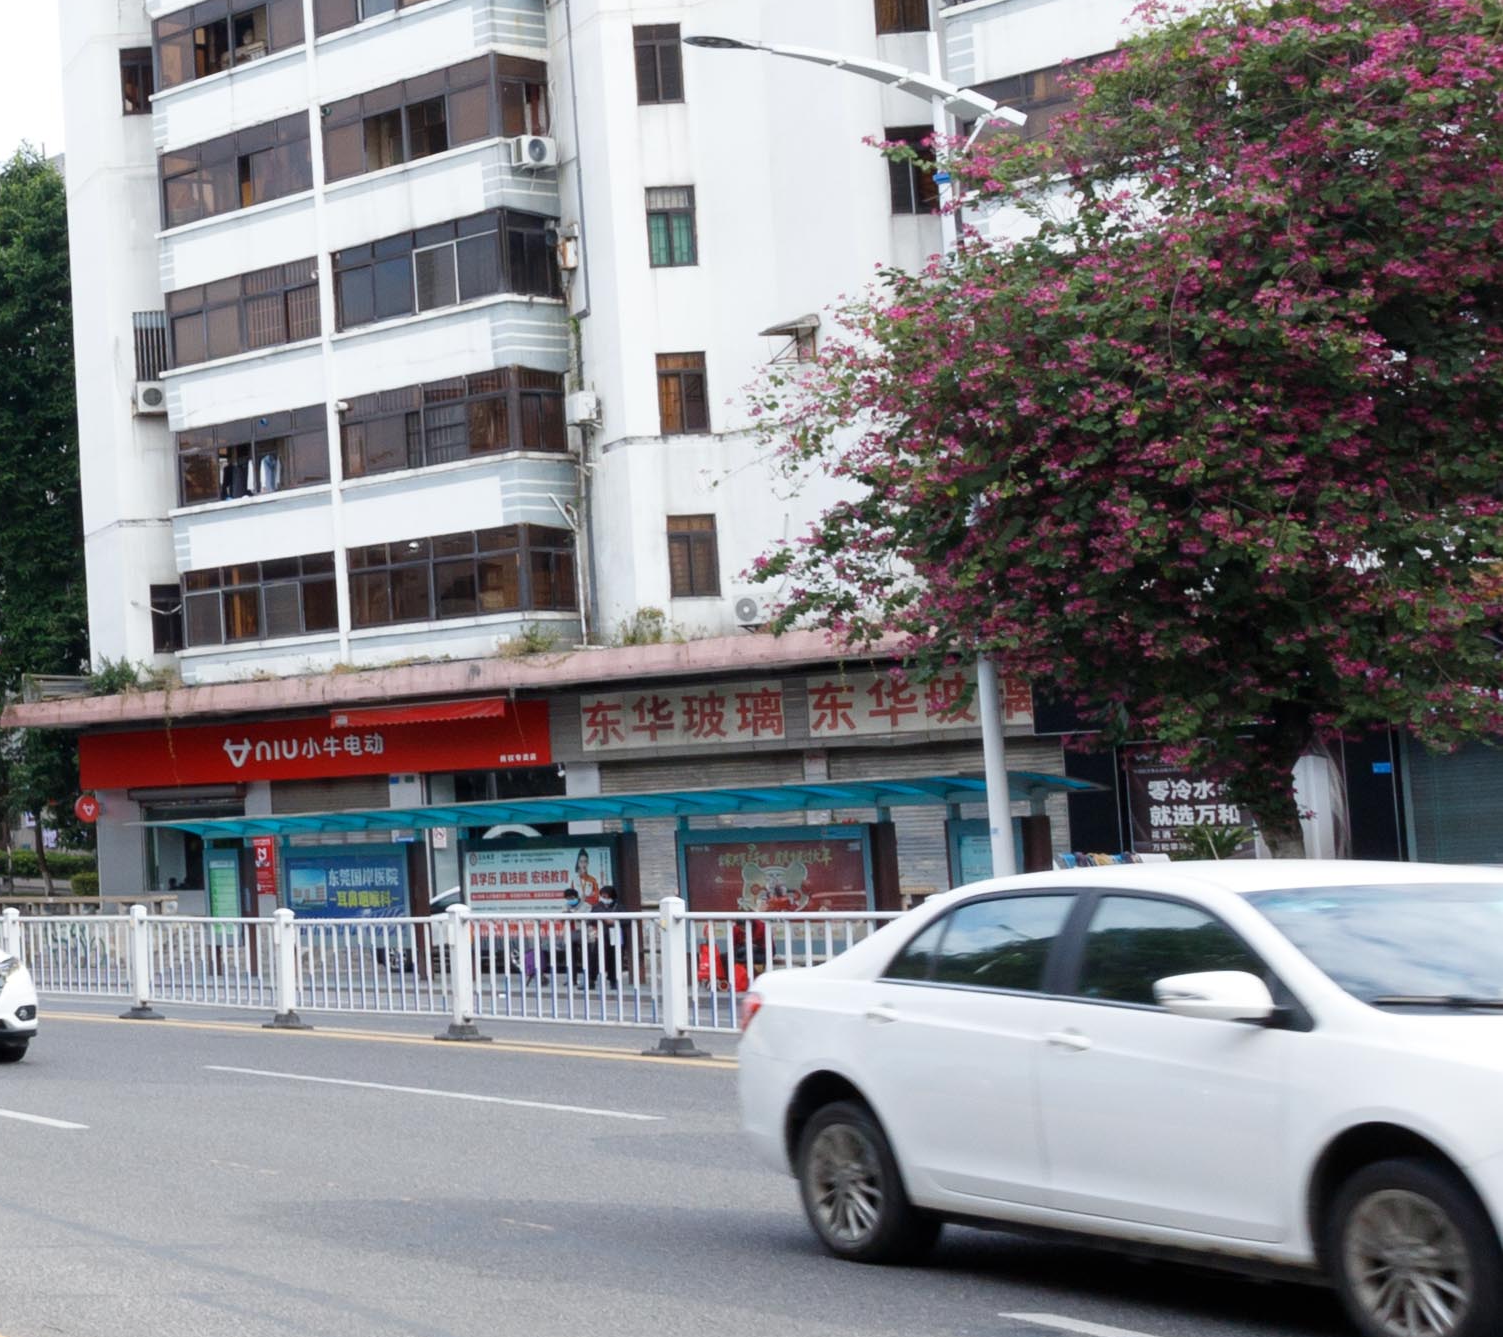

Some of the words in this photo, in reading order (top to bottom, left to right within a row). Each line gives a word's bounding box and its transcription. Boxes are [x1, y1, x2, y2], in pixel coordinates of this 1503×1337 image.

[808, 670, 1034, 733] 东华玻璃
[581, 686, 784, 747] 东华玻璃
[302, 734, 384, 759] 小牛电动
[1147, 779, 1215, 802] 零冷水
[1149, 804, 1241, 826] 就选万和
